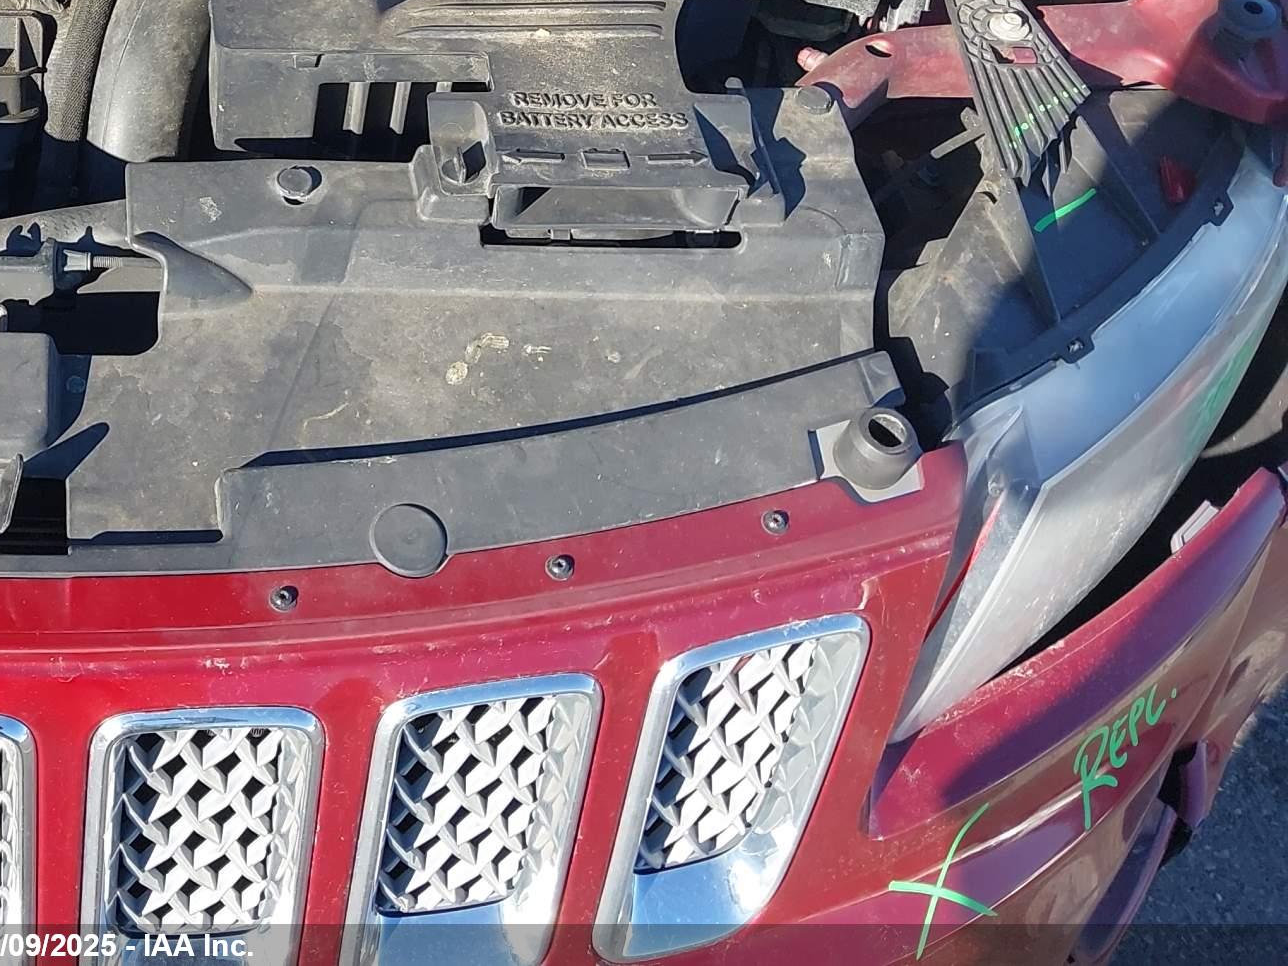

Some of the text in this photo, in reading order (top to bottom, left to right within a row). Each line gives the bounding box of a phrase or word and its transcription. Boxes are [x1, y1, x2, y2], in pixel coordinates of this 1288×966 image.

[513, 91, 658, 108] REMOVE FOR
[500, 111, 690, 130] BATTERY ACCESS
